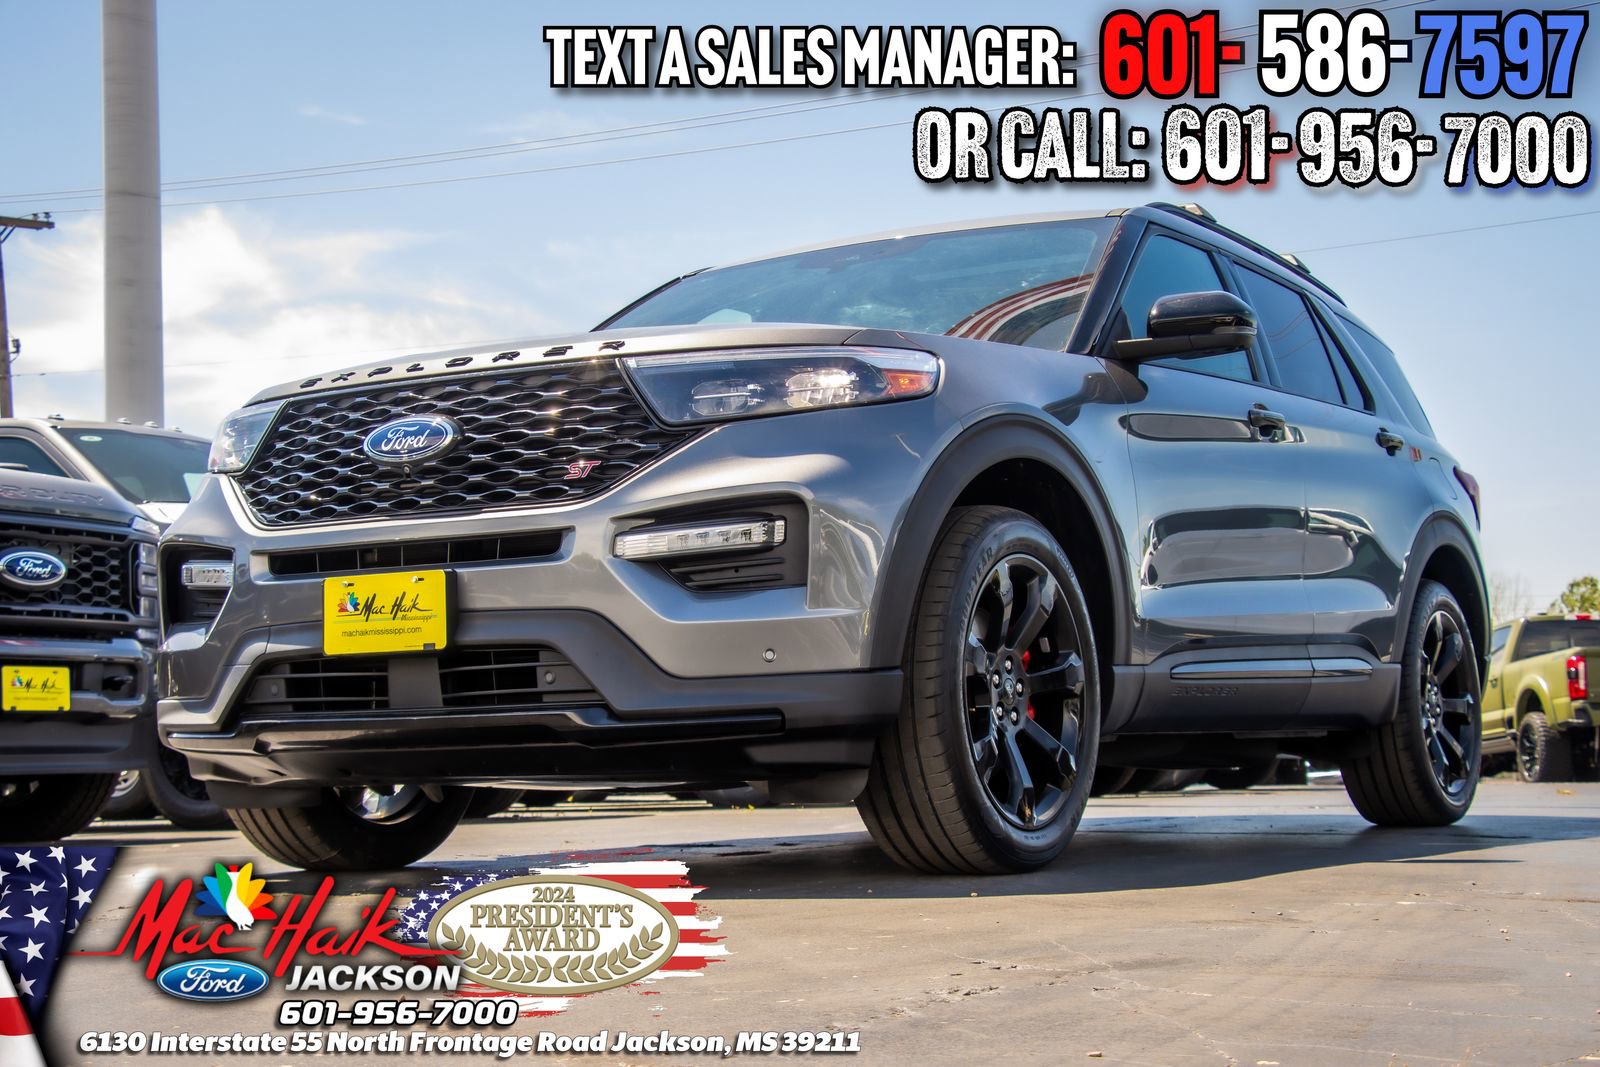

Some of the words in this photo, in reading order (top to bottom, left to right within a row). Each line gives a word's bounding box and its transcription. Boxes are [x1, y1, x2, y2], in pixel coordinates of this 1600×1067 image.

[299, 340, 626, 389] EXPLORER
[381, 424, 428, 451] Ford
[564, 460, 601, 480] ST
[15, 557, 53, 579] Ford
[358, 593, 389, 622] Mac
[390, 591, 431, 621] Haik
[341, 626, 422, 637] machaikmississippi.com
